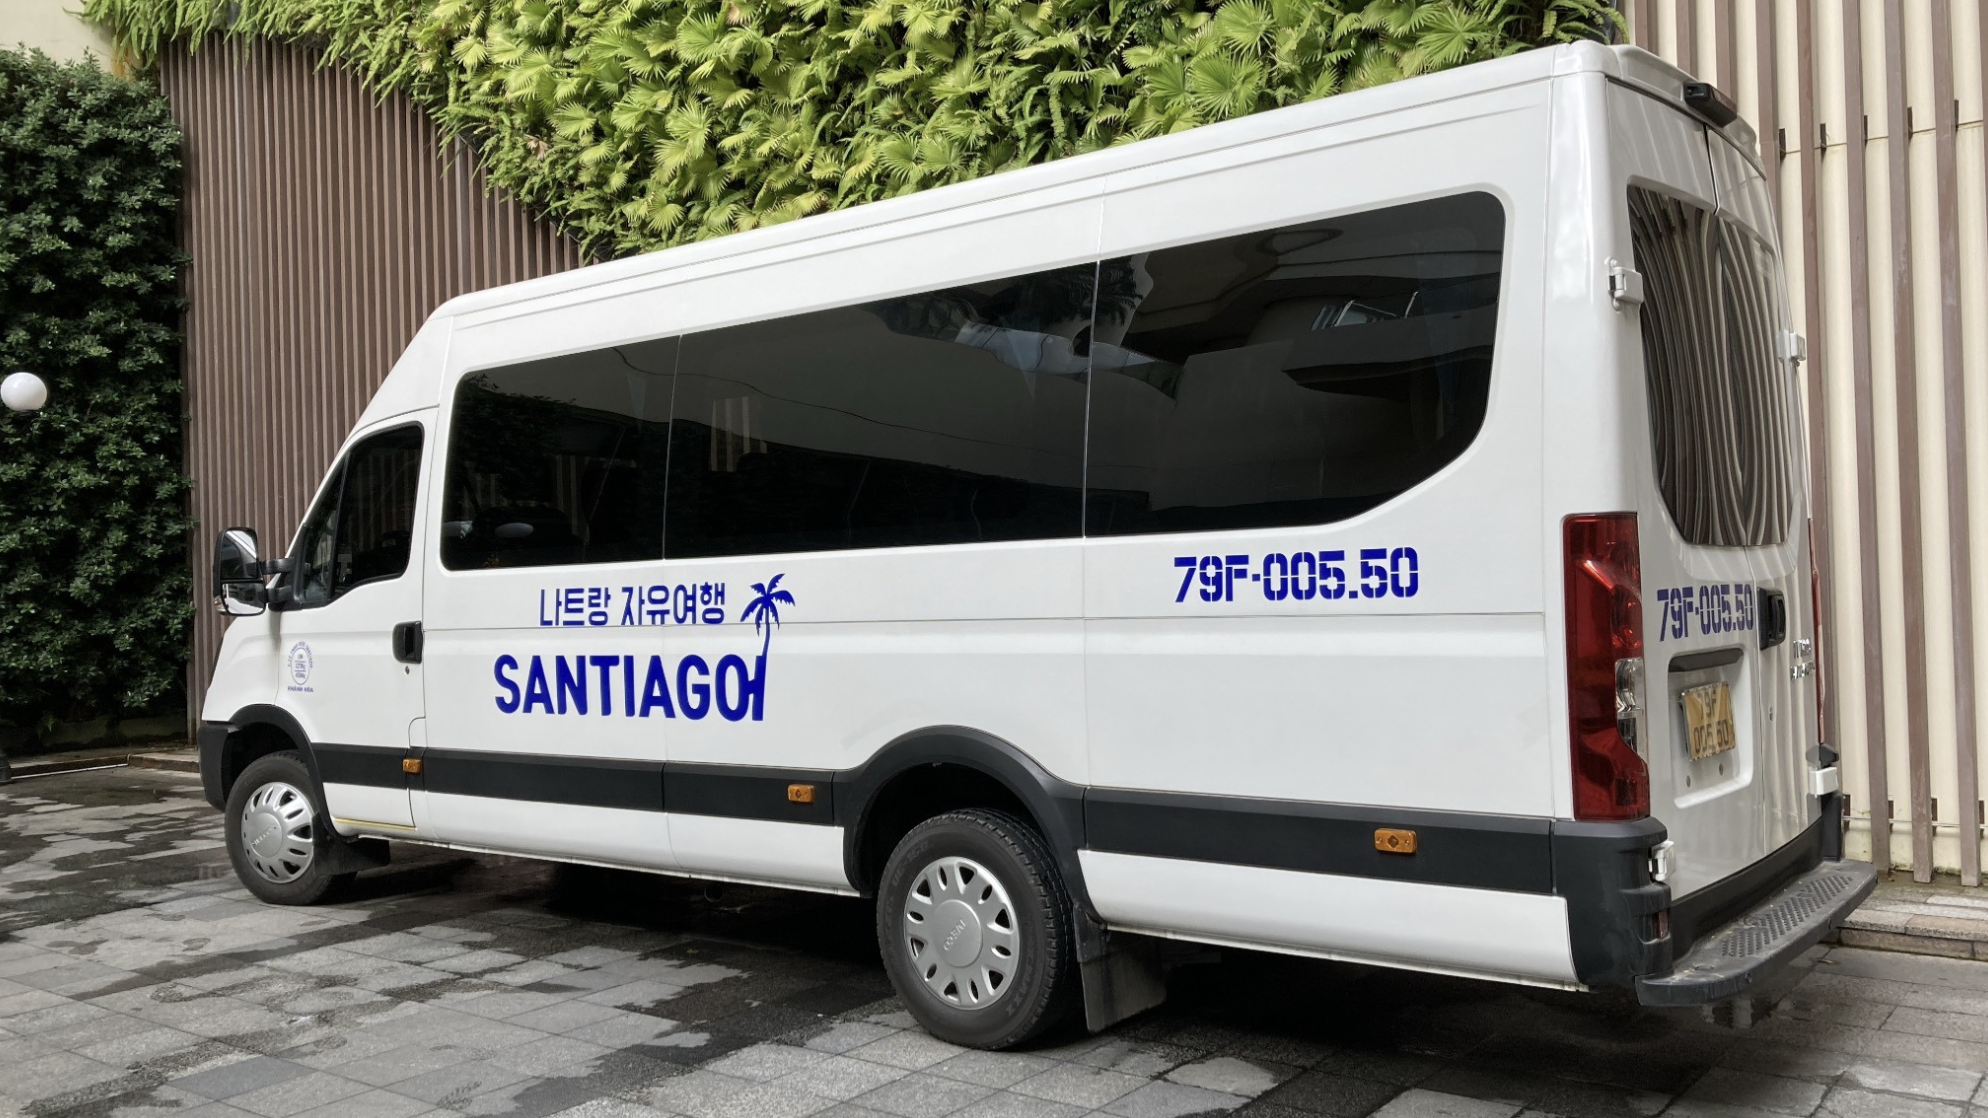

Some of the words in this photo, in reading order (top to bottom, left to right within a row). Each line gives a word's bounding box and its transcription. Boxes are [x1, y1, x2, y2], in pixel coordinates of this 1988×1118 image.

[1174, 546, 1418, 602] 79F-005.50
[540, 587, 611, 626] 나트랑
[621, 582, 725, 626] 자유여행
[1657, 584, 1754, 642] 79F-005.50
[494, 654, 751, 722] SANTIAGO
[943, 919, 966, 952] IVECO
